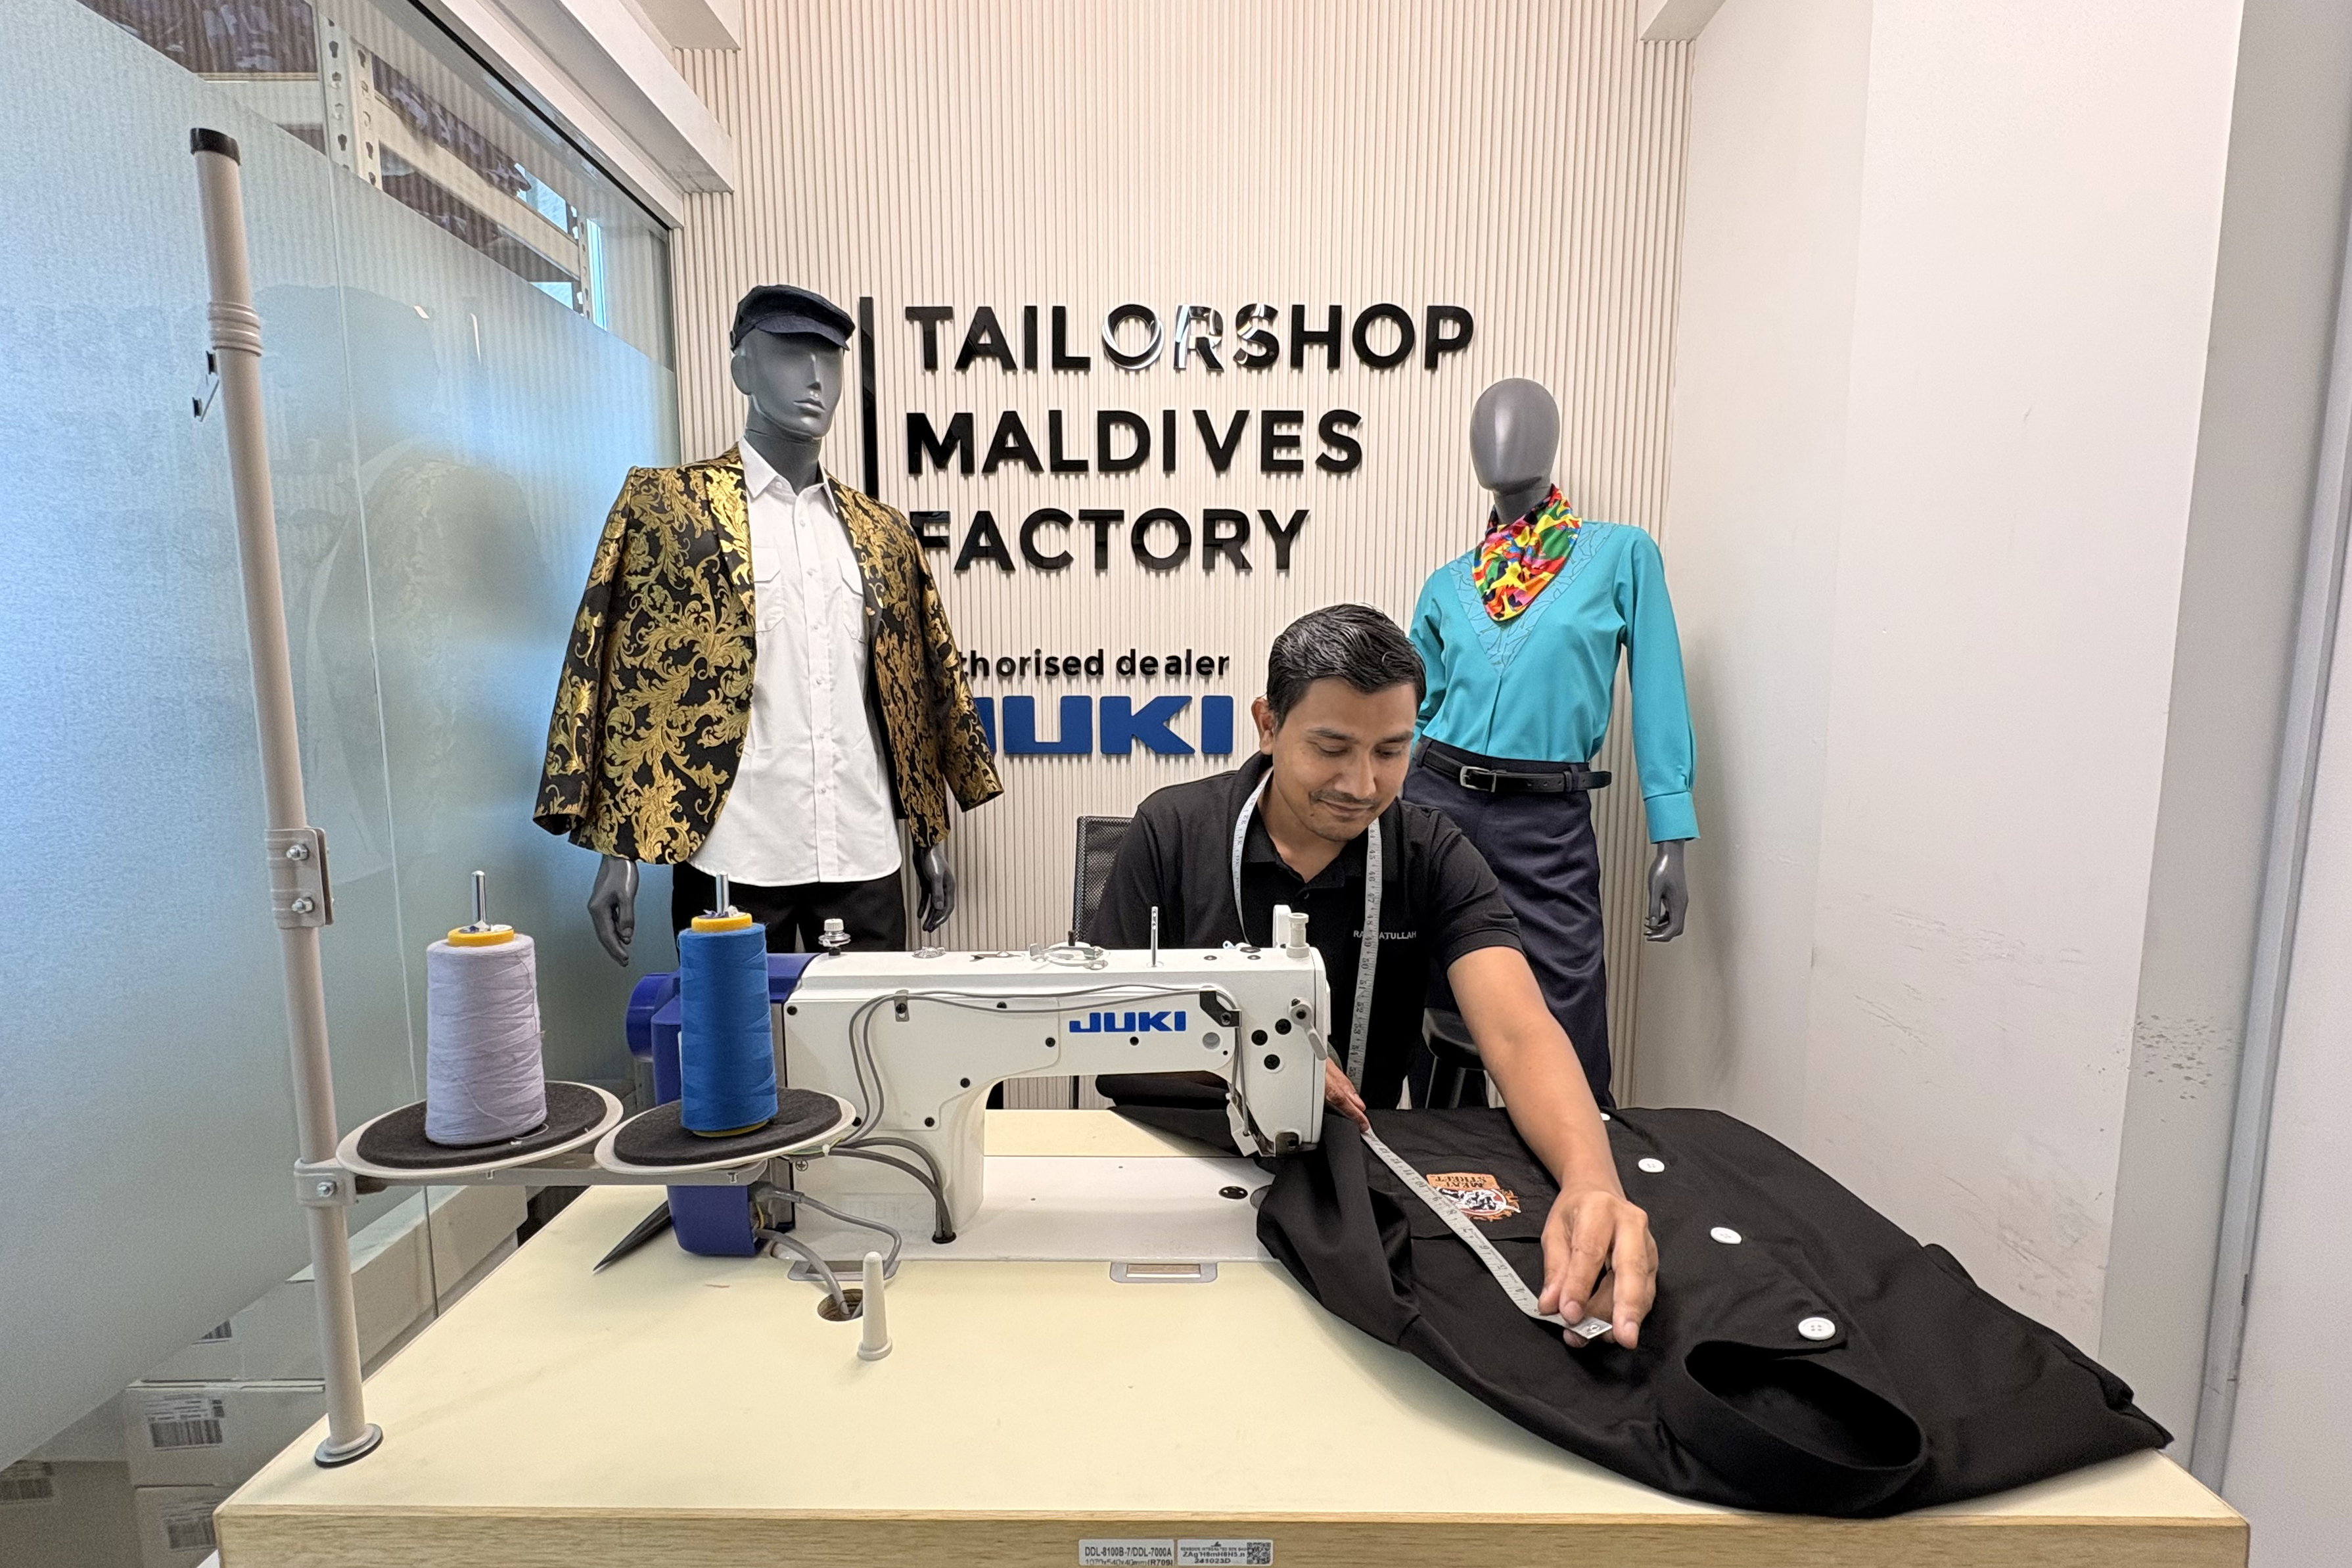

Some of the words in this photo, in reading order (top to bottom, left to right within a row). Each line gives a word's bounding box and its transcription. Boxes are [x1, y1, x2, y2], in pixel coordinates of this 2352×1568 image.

[906, 303, 1474, 371] TAILORSHOP
[906, 409, 1362, 474] MALDIVES
[910, 507, 1310, 572] FACTORY
[1117, 649, 1230, 676] dealer
[1367, 892, 1375, 904] 47
[1366, 914, 1373, 925] 48
[1353, 930, 1417, 940] RAATULLAH
[1364, 936, 1372, 948] 49
[1361, 957, 1370, 969] 50
[1358, 979, 1367, 990] 51
[1356, 1002, 1364, 1013] 52
[1069, 1011, 1186, 1033] JUKI
[1085, 1546, 1172, 1557] DDL-8100B-7/DDL-7000A
